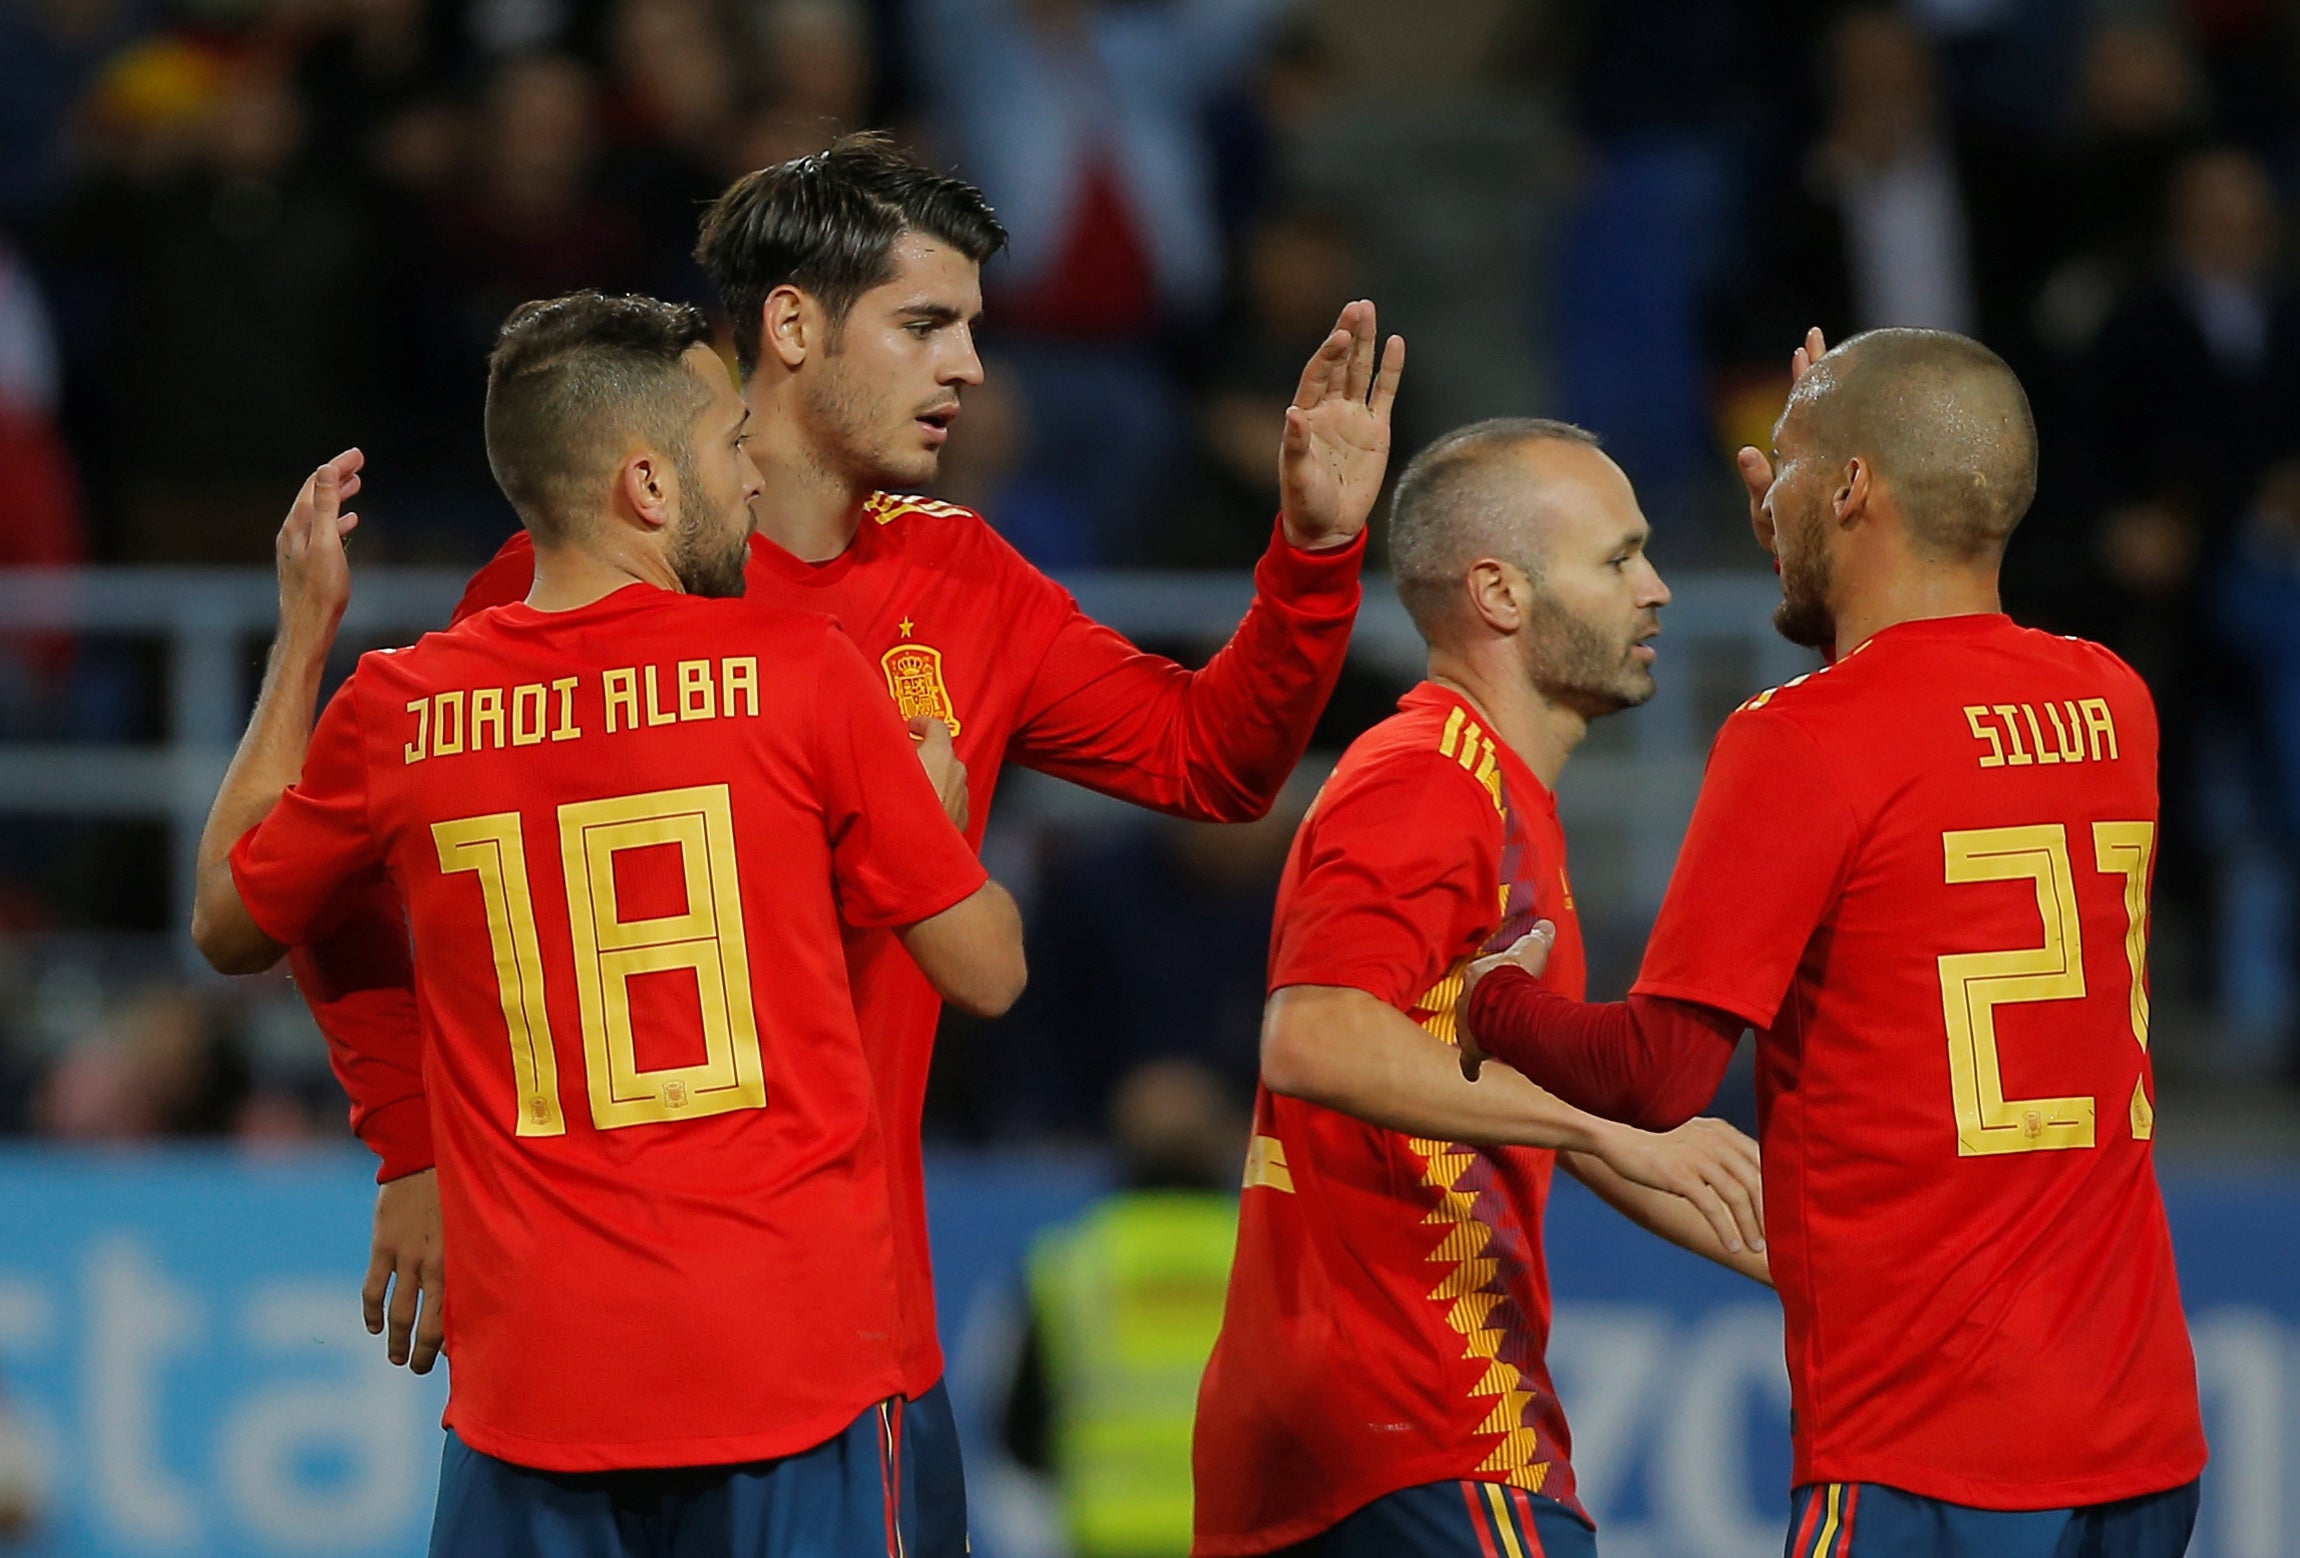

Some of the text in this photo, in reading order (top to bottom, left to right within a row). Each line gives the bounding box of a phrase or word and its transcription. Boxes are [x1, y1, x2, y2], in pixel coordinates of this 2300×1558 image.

[602, 656, 759, 733] ALBA
[1963, 697, 2119, 767] SILVA
[430, 783, 767, 1137] 18
[1937, 820, 2155, 1157] 21
